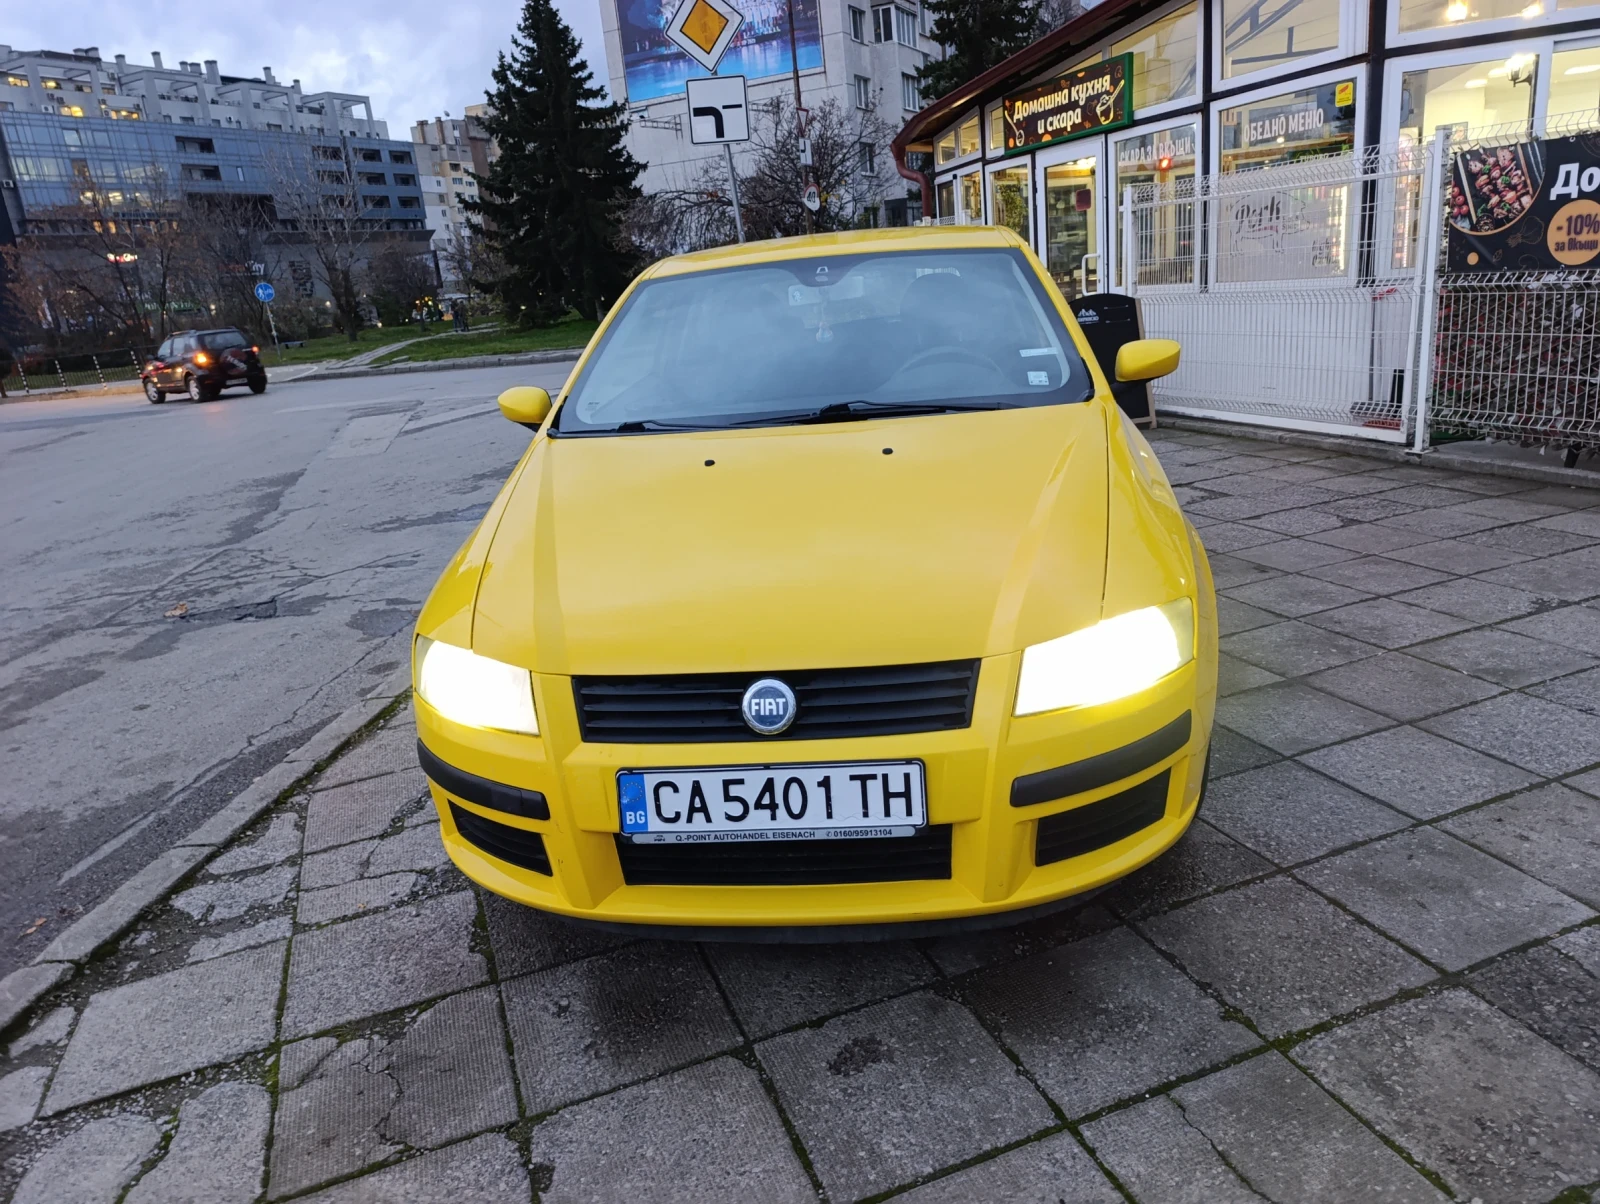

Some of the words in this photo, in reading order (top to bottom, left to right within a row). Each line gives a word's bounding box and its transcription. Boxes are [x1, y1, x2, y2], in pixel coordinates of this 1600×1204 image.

[1013, 88, 1069, 123] Домашна
[1071, 75, 1111, 105] кухня
[1037, 119, 1045, 134] и
[1046, 108, 1082, 131] скара
[1244, 116, 1286, 142] ОБЕДНО
[1288, 108, 1324, 134] МЕНЮ
[1120, 147, 1145, 162] СКАРА
[1147, 144, 1157, 161] ЗА
[1159, 136, 1191, 159] ВКЪЩИ
[1554, 242, 1565, 252] за
[1567, 238, 1599, 251] вкъщи
[751, 697, 786, 716] FIAT
[652, 780, 713, 823] CA
[722, 775, 833, 822] 5401
[849, 772, 913, 818] TH
[626, 811, 646, 824] BG
[675, 833, 712, 842] Q.-POINT
[713, 831, 771, 841] AUTOHANDEL
[772, 830, 815, 839] EISENACH
[833, 828, 893, 838] 0160/95913104
